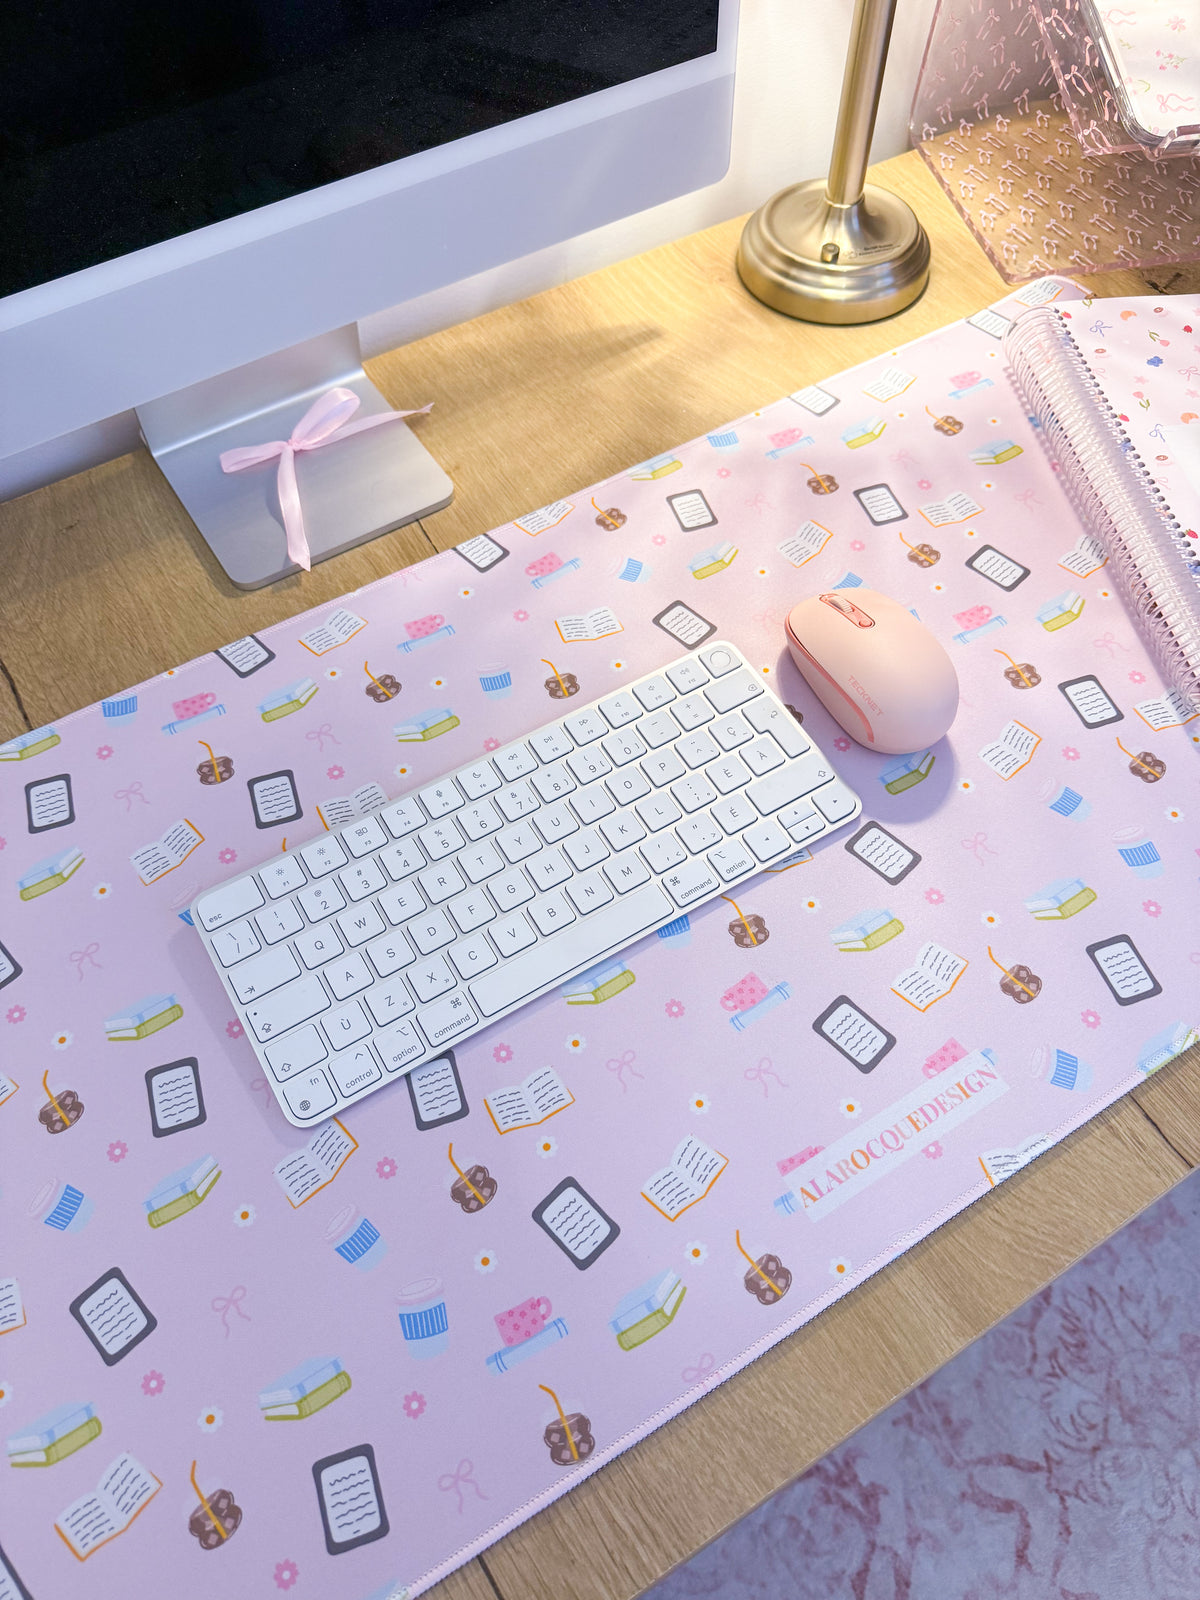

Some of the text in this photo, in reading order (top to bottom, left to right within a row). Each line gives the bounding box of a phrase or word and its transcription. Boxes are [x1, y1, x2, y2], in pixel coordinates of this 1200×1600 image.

[727, 727, 736, 736] Ç
[659, 763, 665, 771] P
[553, 783, 561, 791] 8
[624, 781, 632, 789] O
[516, 801, 522, 809] 7
[551, 817, 560, 826] U
[619, 825, 628, 834] K
[441, 840, 449, 848] 5
[514, 837, 521, 845] Y
[585, 845, 590, 853] J
[476, 856, 486, 865] T
[544, 864, 554, 874] H
[621, 866, 632, 877] M
[725, 860, 747, 875] option
[362, 880, 370, 889] 3
[437, 877, 447, 886] R
[507, 885, 515, 893] G
[585, 887, 594, 896] N
[680, 878, 712, 900] command
[321, 901, 329, 910] 2
[398, 898, 406, 907] E
[468, 905, 474, 914] F
[547, 908, 556, 917] B
[209, 914, 222, 922] esc
[354, 917, 366, 928] W
[427, 927, 436, 936] D
[507, 928, 515, 937] V
[314, 941, 324, 950] Q
[387, 948, 395, 958] S
[468, 951, 477, 960] C
[346, 972, 354, 981] A
[427, 972, 437, 983] X
[385, 996, 394, 1006] Z
[341, 1019, 351, 1030] Ù
[434, 1014, 470, 1038] command
[392, 1045, 417, 1062] option
[346, 1069, 373, 1089] control
[799, 1064, 998, 1208] ALAROCQUEDESIGN
